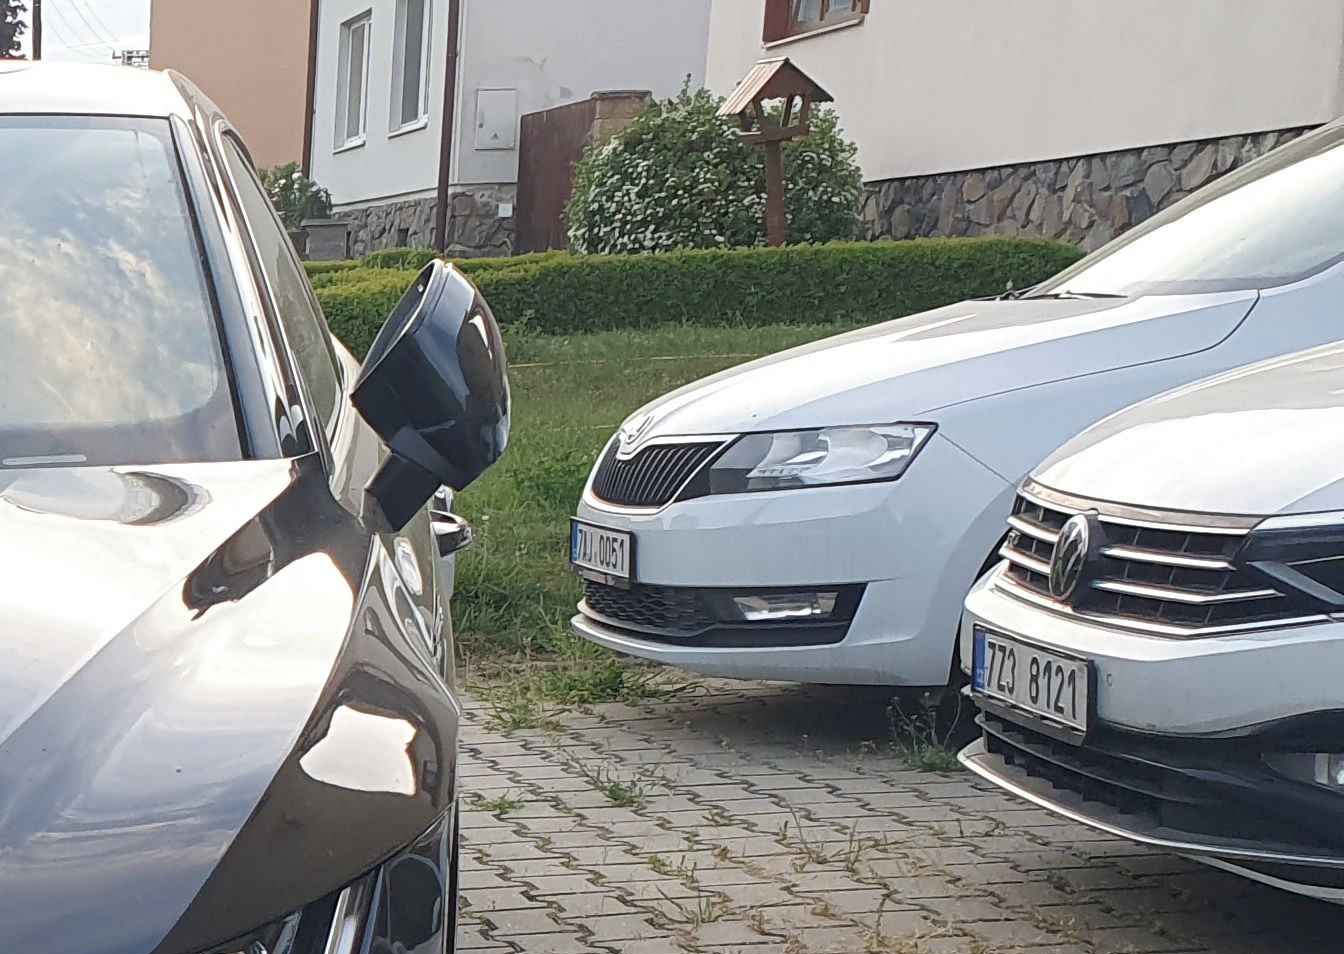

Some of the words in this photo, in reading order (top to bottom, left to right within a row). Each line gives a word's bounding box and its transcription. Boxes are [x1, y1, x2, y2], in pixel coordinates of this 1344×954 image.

[598, 534, 625, 572] 0051
[986, 640, 1017, 695] 7Z3
[1028, 655, 1077, 721] 8121
